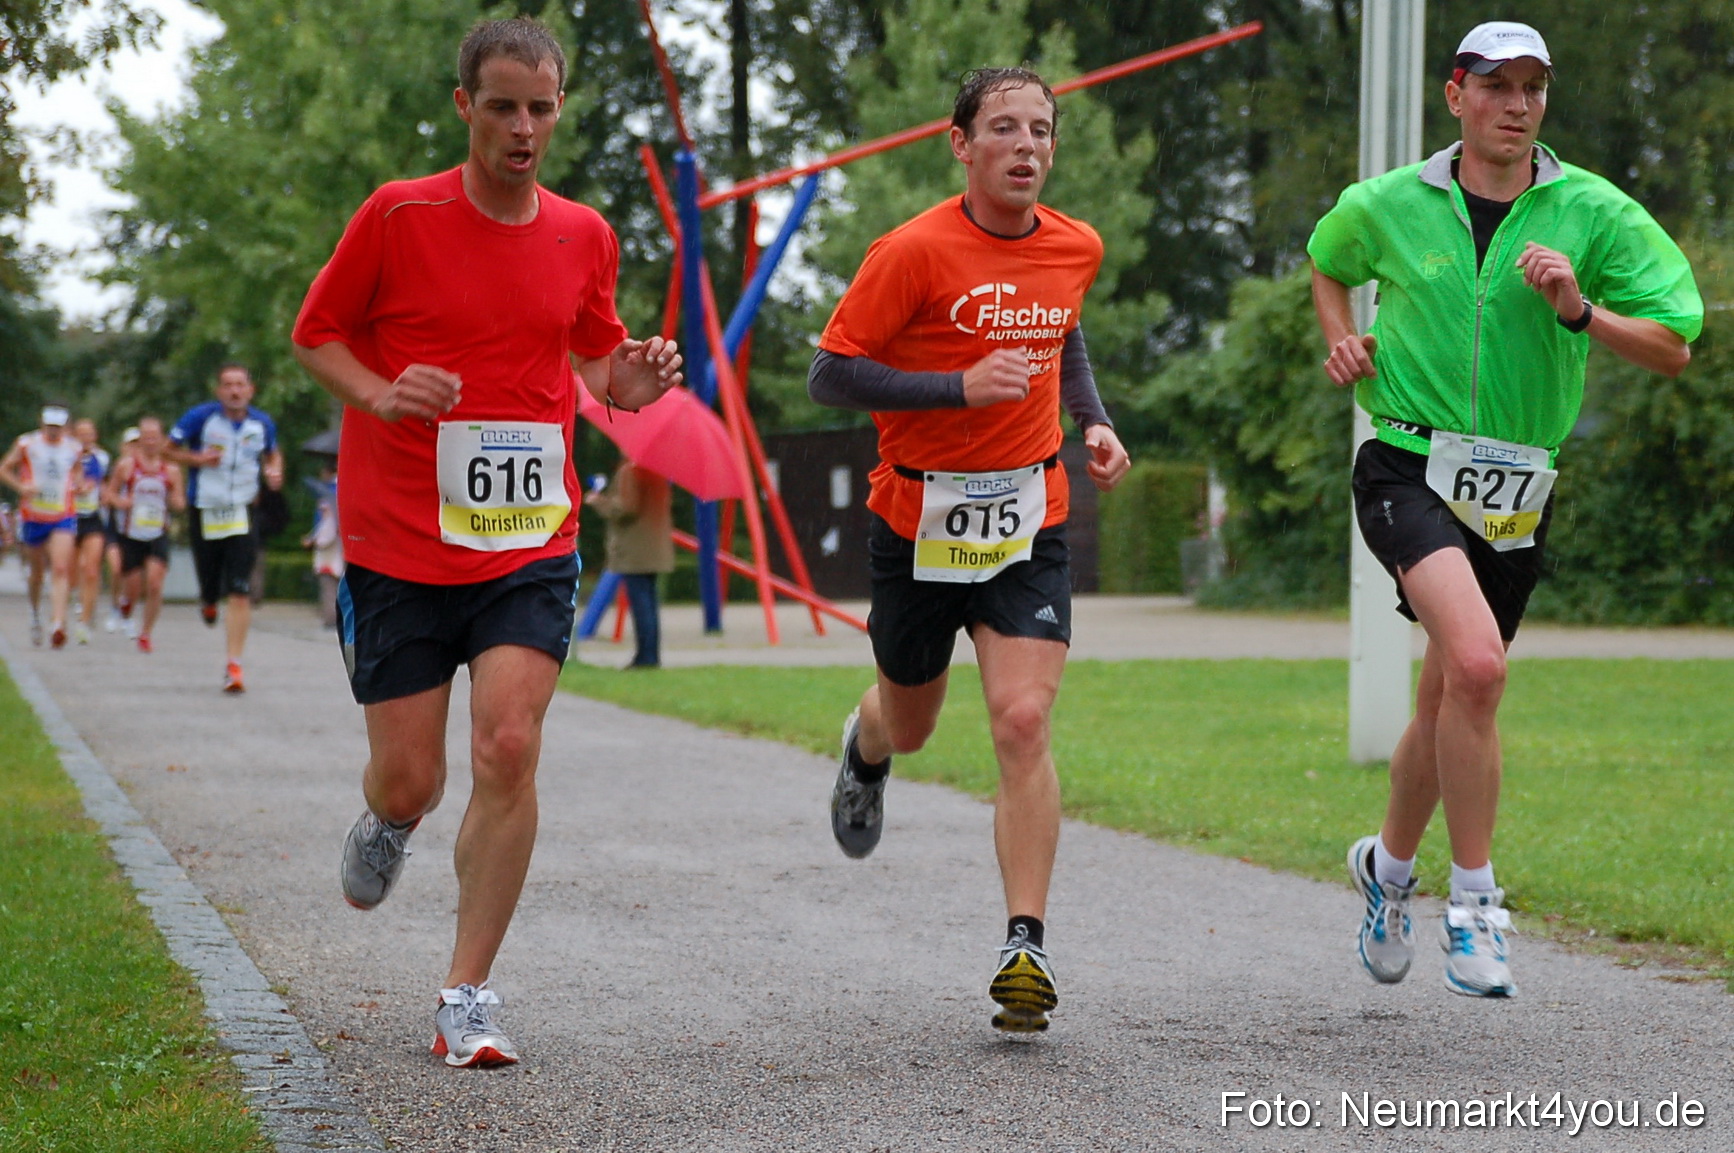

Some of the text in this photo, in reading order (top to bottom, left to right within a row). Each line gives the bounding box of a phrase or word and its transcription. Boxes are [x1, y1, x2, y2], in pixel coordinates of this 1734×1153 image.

[976, 302, 1071, 327] Fischer
[985, 329, 1064, 340] AUTOMOBILE
[481, 430, 531, 443] BOCK
[1473, 445, 1517, 459] BOCK
[467, 456, 543, 503] 616
[965, 478, 1013, 492] BOCK
[1452, 467, 1536, 511] 627
[470, 513, 546, 533] Christian
[945, 498, 1021, 539] 615
[948, 547, 1006, 566] Thomas
